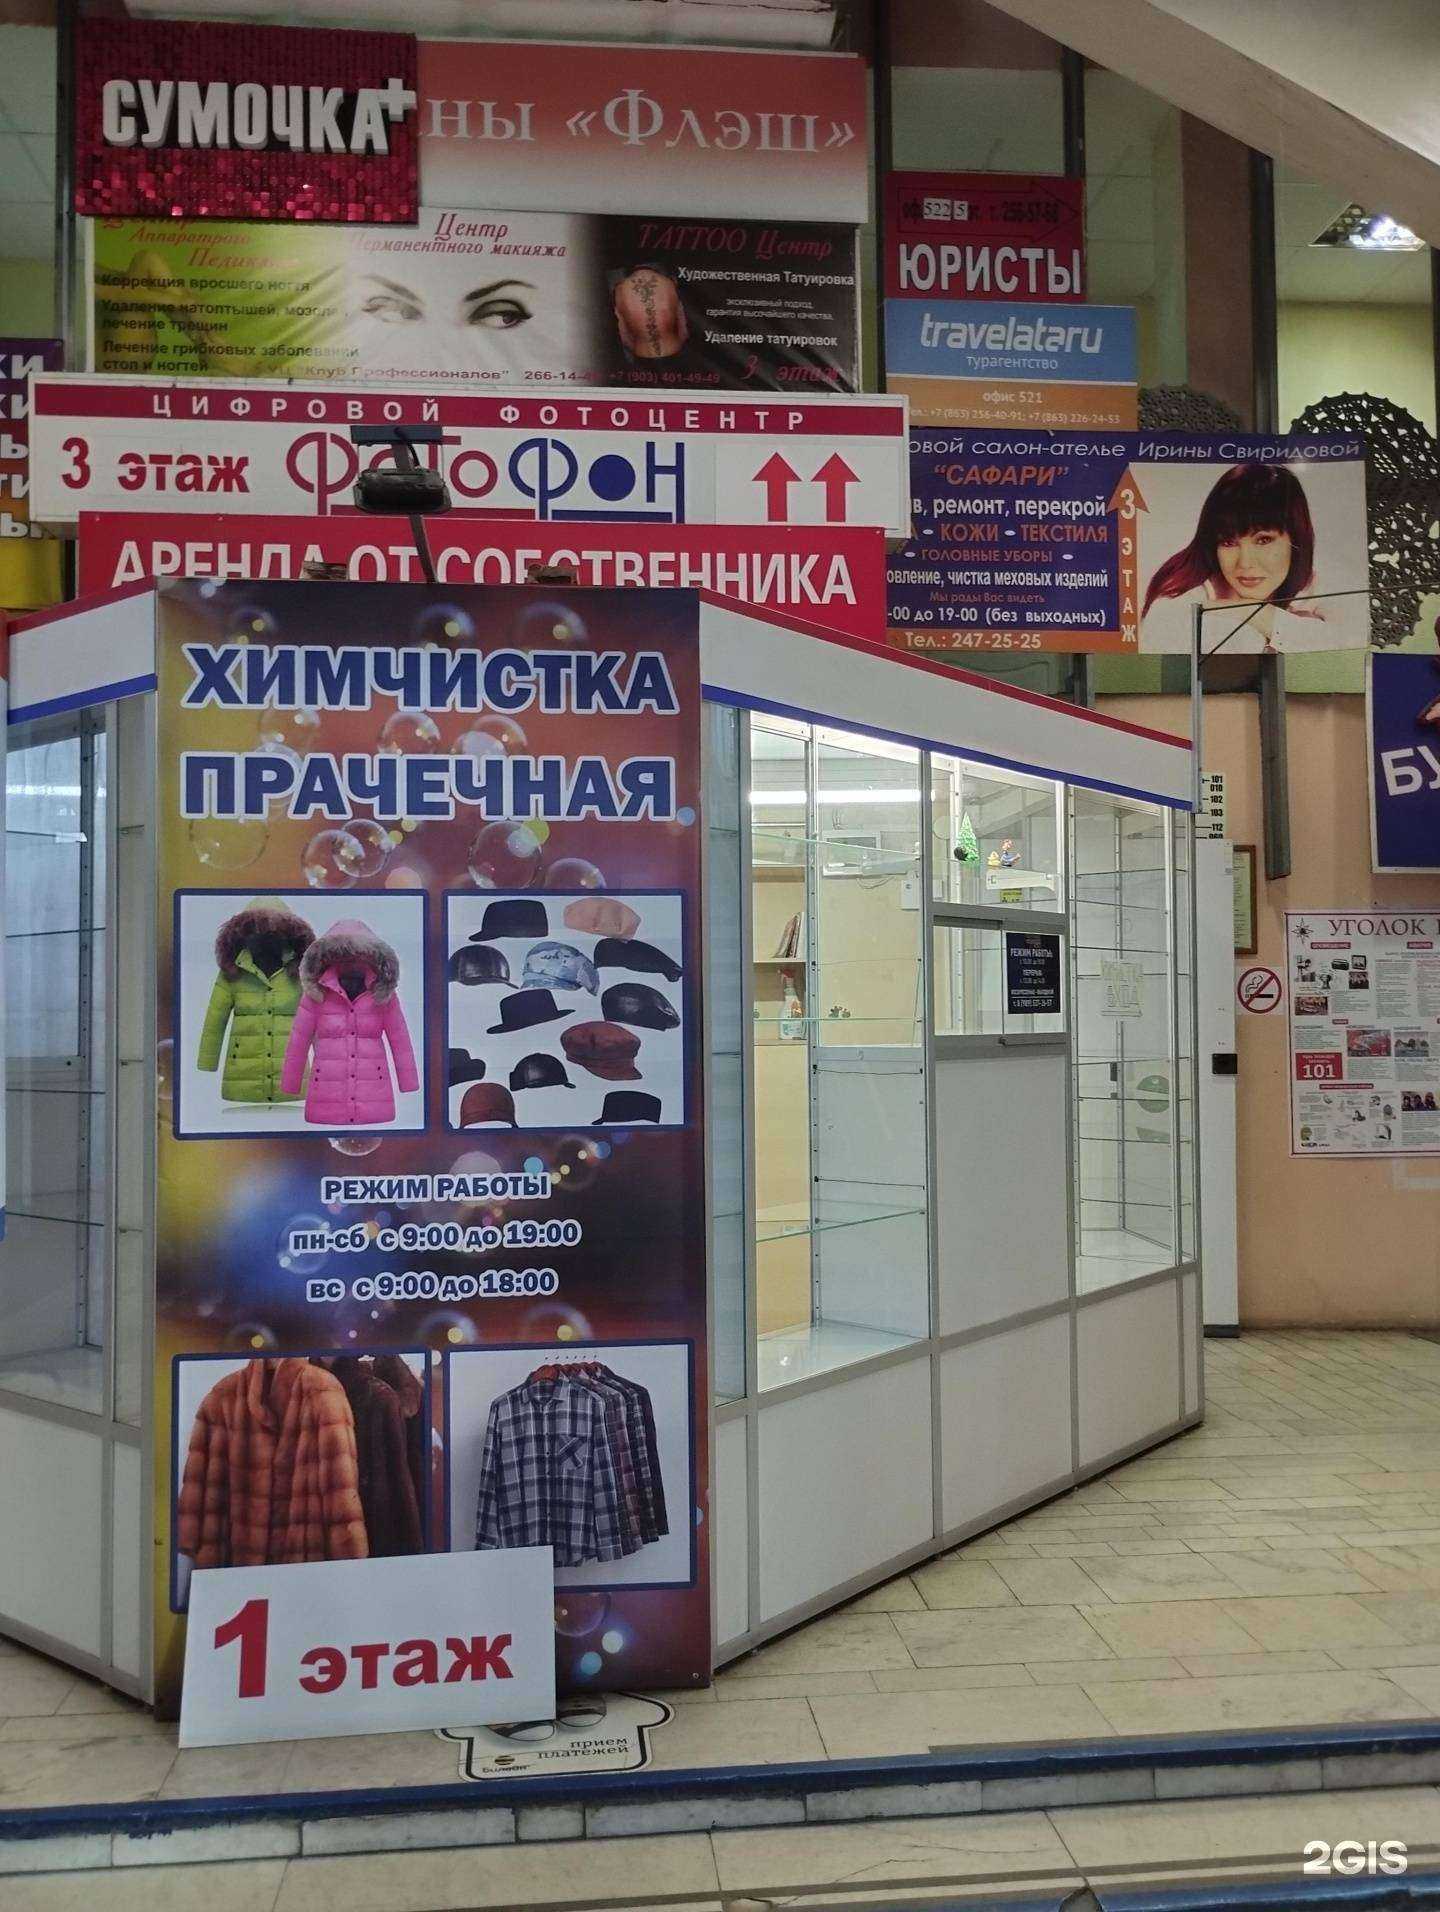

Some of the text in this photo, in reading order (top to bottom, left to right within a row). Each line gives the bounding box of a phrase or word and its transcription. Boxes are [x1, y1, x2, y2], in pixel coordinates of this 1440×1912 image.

[103, 78, 417, 155] СУМОЧКА+
[434, 213, 508, 242] Центр
[490, 243, 567, 257] макияжа
[756, 230, 832, 261] Центр
[678, 267, 854, 286] Художественная Татуировка
[899, 243, 1081, 294] ЮРИСТЫ
[101, 274, 185, 290] Коррекция
[190, 278, 263, 292] вросшего
[101, 300, 175, 316] Удаление
[171, 320, 228, 334] трещин
[704, 330, 838, 347] Удаление татуировок
[103, 340, 167, 354] Лечение
[172, 343, 256, 357] грибковых
[103, 359, 209, 372] стоп и ногтей
[966, 355, 1058, 370] турагентство
[982, 390, 1043, 405] офис 521
[153, 395, 804, 430] ЦИФРОВОЙ ФОТОЦЕНТР
[909, 408, 929, 417] ел.:
[972, 440, 1125, 457] салон-ателье
[1138, 441, 1212, 460] Ирины
[1219, 440, 1360, 462] Свиридовой
[61, 437, 250, 493] 3 этаж
[933, 498, 1010, 518] ремонт,
[1015, 495, 1106, 519] перекрой
[1120, 488, 1136, 520] 3
[940, 523, 998, 542] КОЖИ
[1020, 523, 1108, 543] ТЕКСТИЛЯ
[922, 549, 1053, 563] ГОЛОВНЫЕ УБОРЫ
[948, 571, 991, 586] чистка
[994, 571, 1051, 587] меховых
[1055, 569, 1108, 590] изделий
[930, 591, 1045, 604] Мы рады Вас видеть
[914, 610, 933, 622] до
[938, 607, 978, 622] 19-00
[986, 607, 1018, 626] (без
[1026, 609, 1107, 627] выходных)
[905, 632, 1042, 649] Тел.: 247-25-25
[182, 644, 680, 714] ХИМЧИСТКА
[181, 752, 676, 821] ПРАЧЕЧНАЯ
[1211, 823, 1224, 832] 112
[1328, 919, 1426, 936] УГОЛОК
[1303, 1064, 1336, 1079] 101
[322, 1173, 549, 1202] РЕЖИМ РАБОТЫ
[291, 1221, 580, 1252] пн-сб с 9:00 до 19:00
[308, 1269, 556, 1300] вс с 9:00 до 18:00
[214, 1598, 514, 1698] 1 этаж
[538, 1746, 629, 1759] платежей
[570, 1737, 628, 1751] прием
